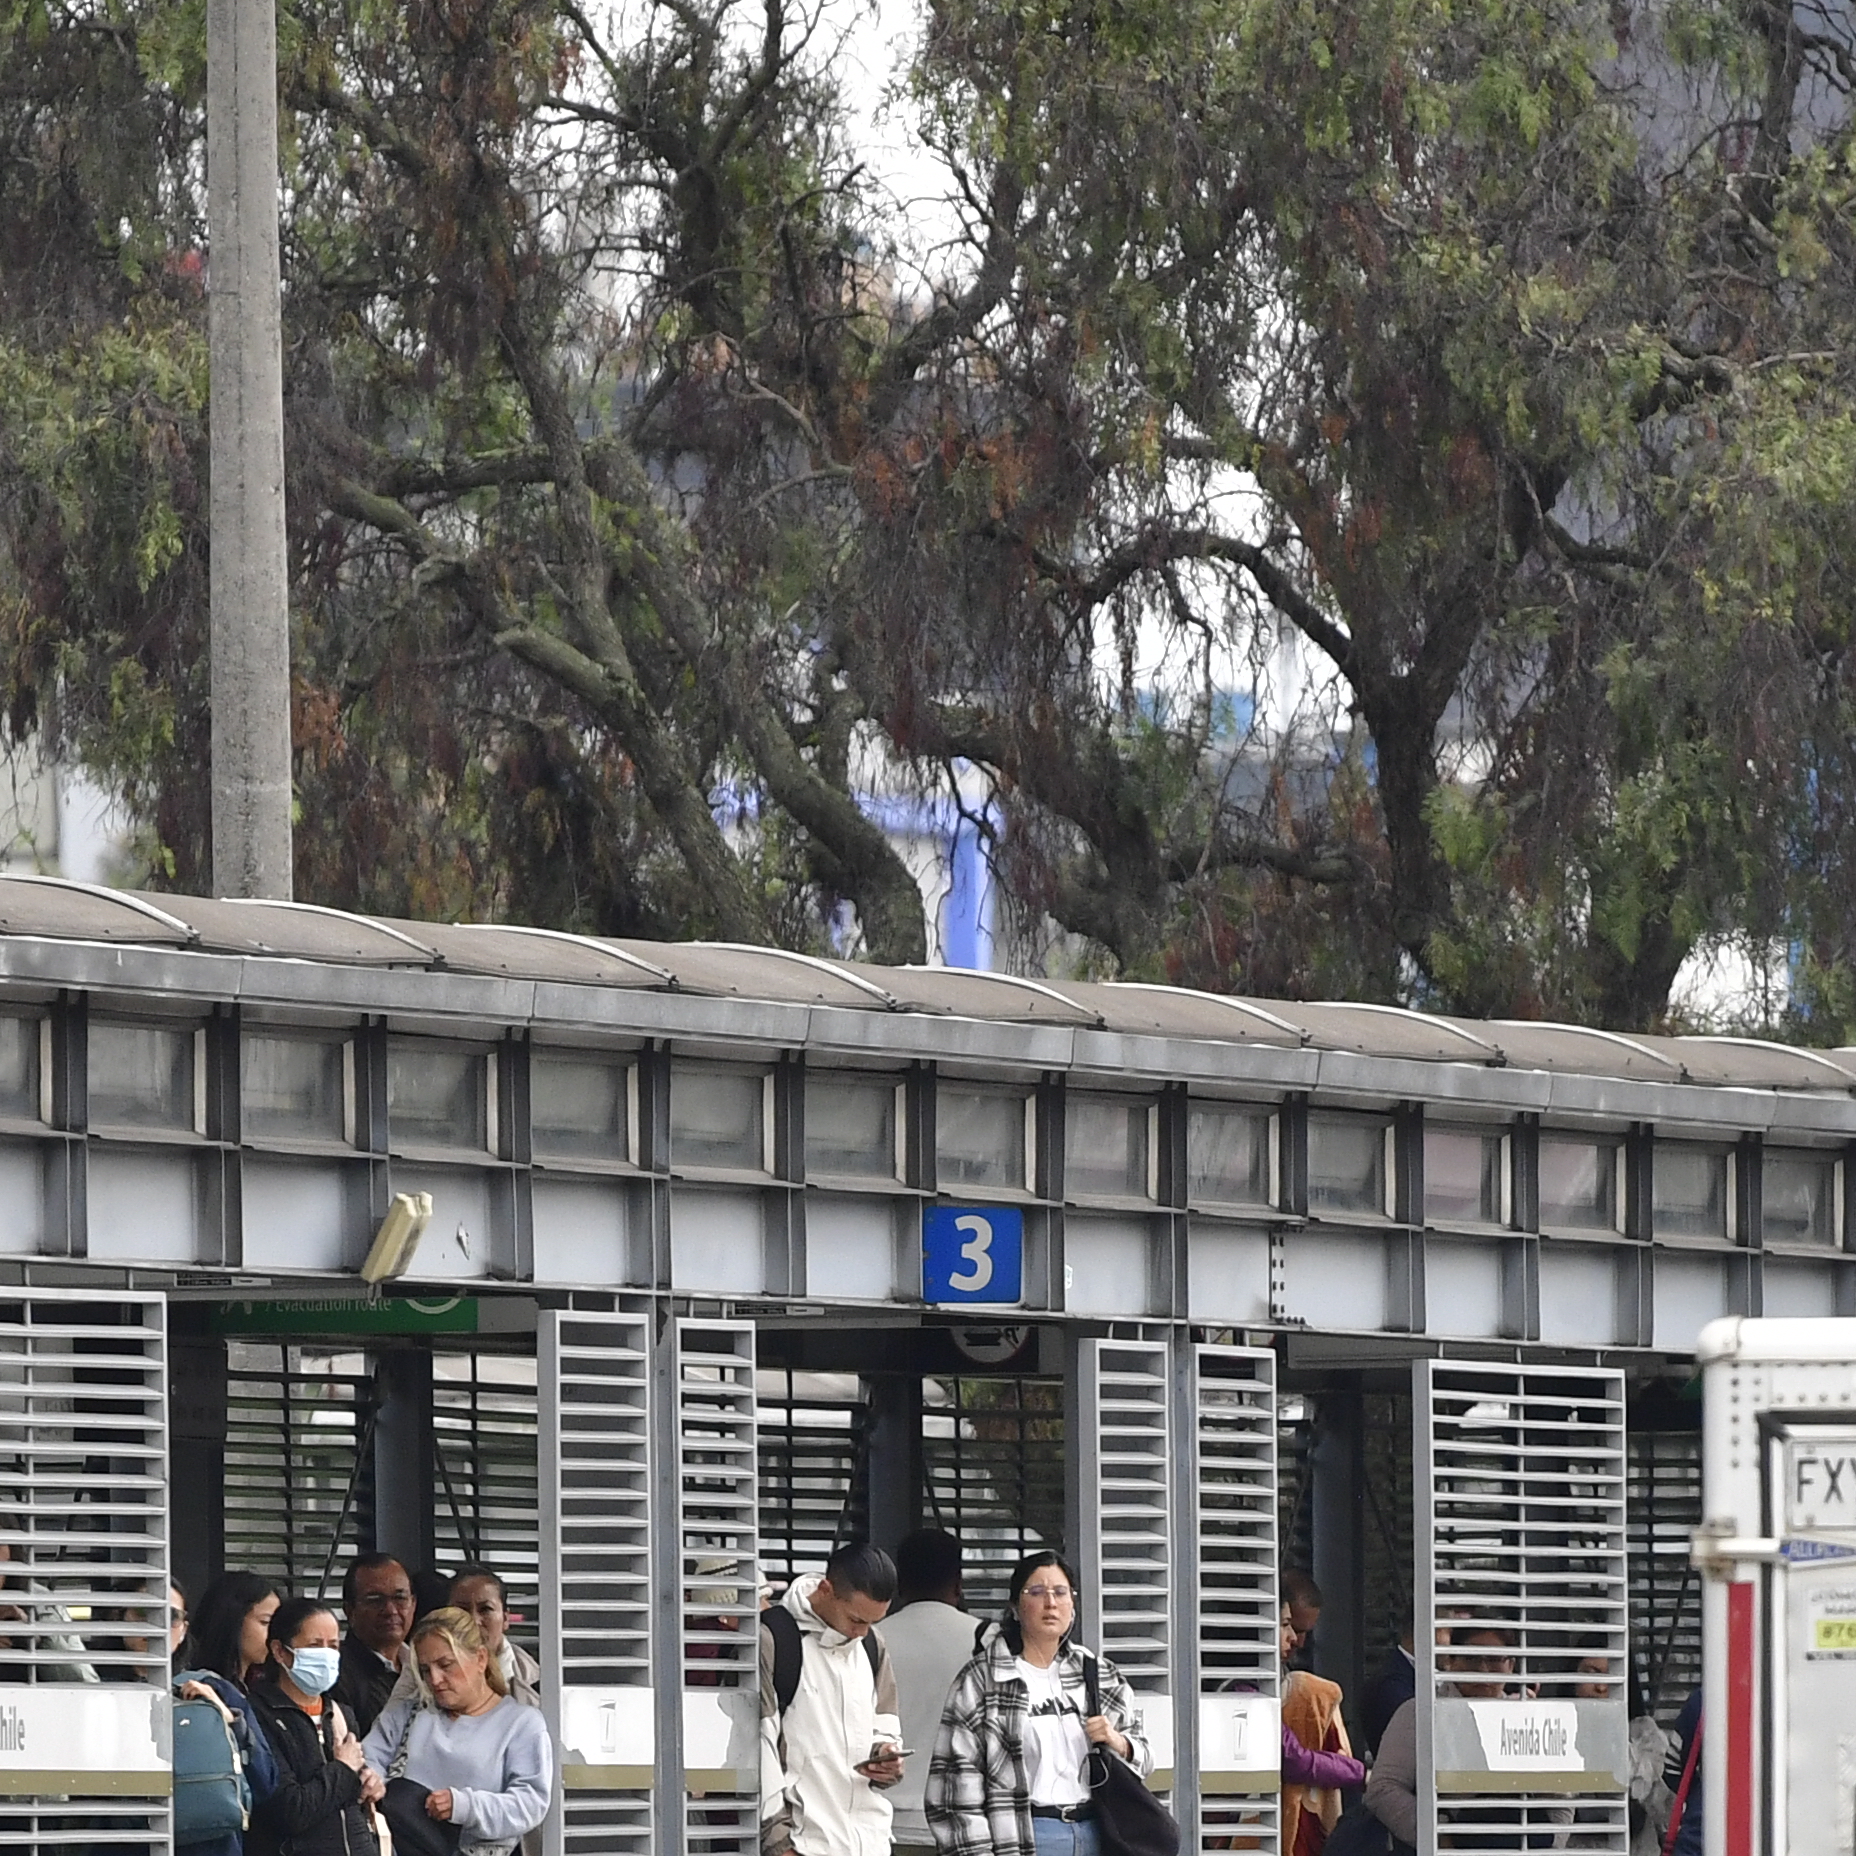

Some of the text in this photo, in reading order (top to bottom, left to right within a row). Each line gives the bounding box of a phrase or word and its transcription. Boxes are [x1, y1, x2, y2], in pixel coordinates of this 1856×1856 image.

[949, 1215, 993, 1292] 3
[1500, 1717, 1567, 1757] Avenida Chile
